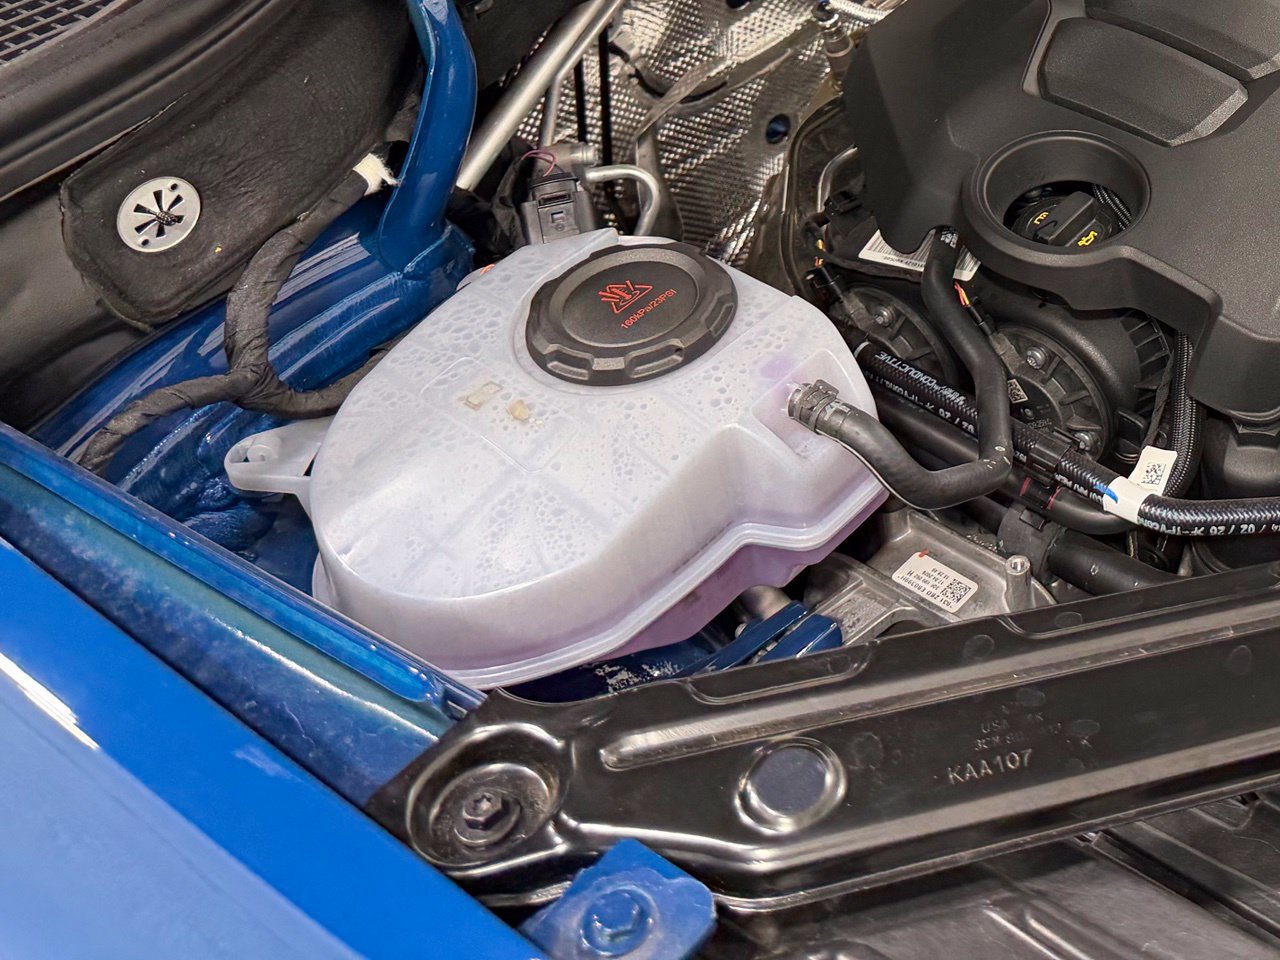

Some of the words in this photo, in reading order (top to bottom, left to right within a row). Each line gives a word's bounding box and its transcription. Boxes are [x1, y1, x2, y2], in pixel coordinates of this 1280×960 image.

[620, 288, 677, 329] 160kPa/23PSI
[875, 351, 937, 387] CONDUCTIVE
[946, 748, 1033, 786] KAA107
